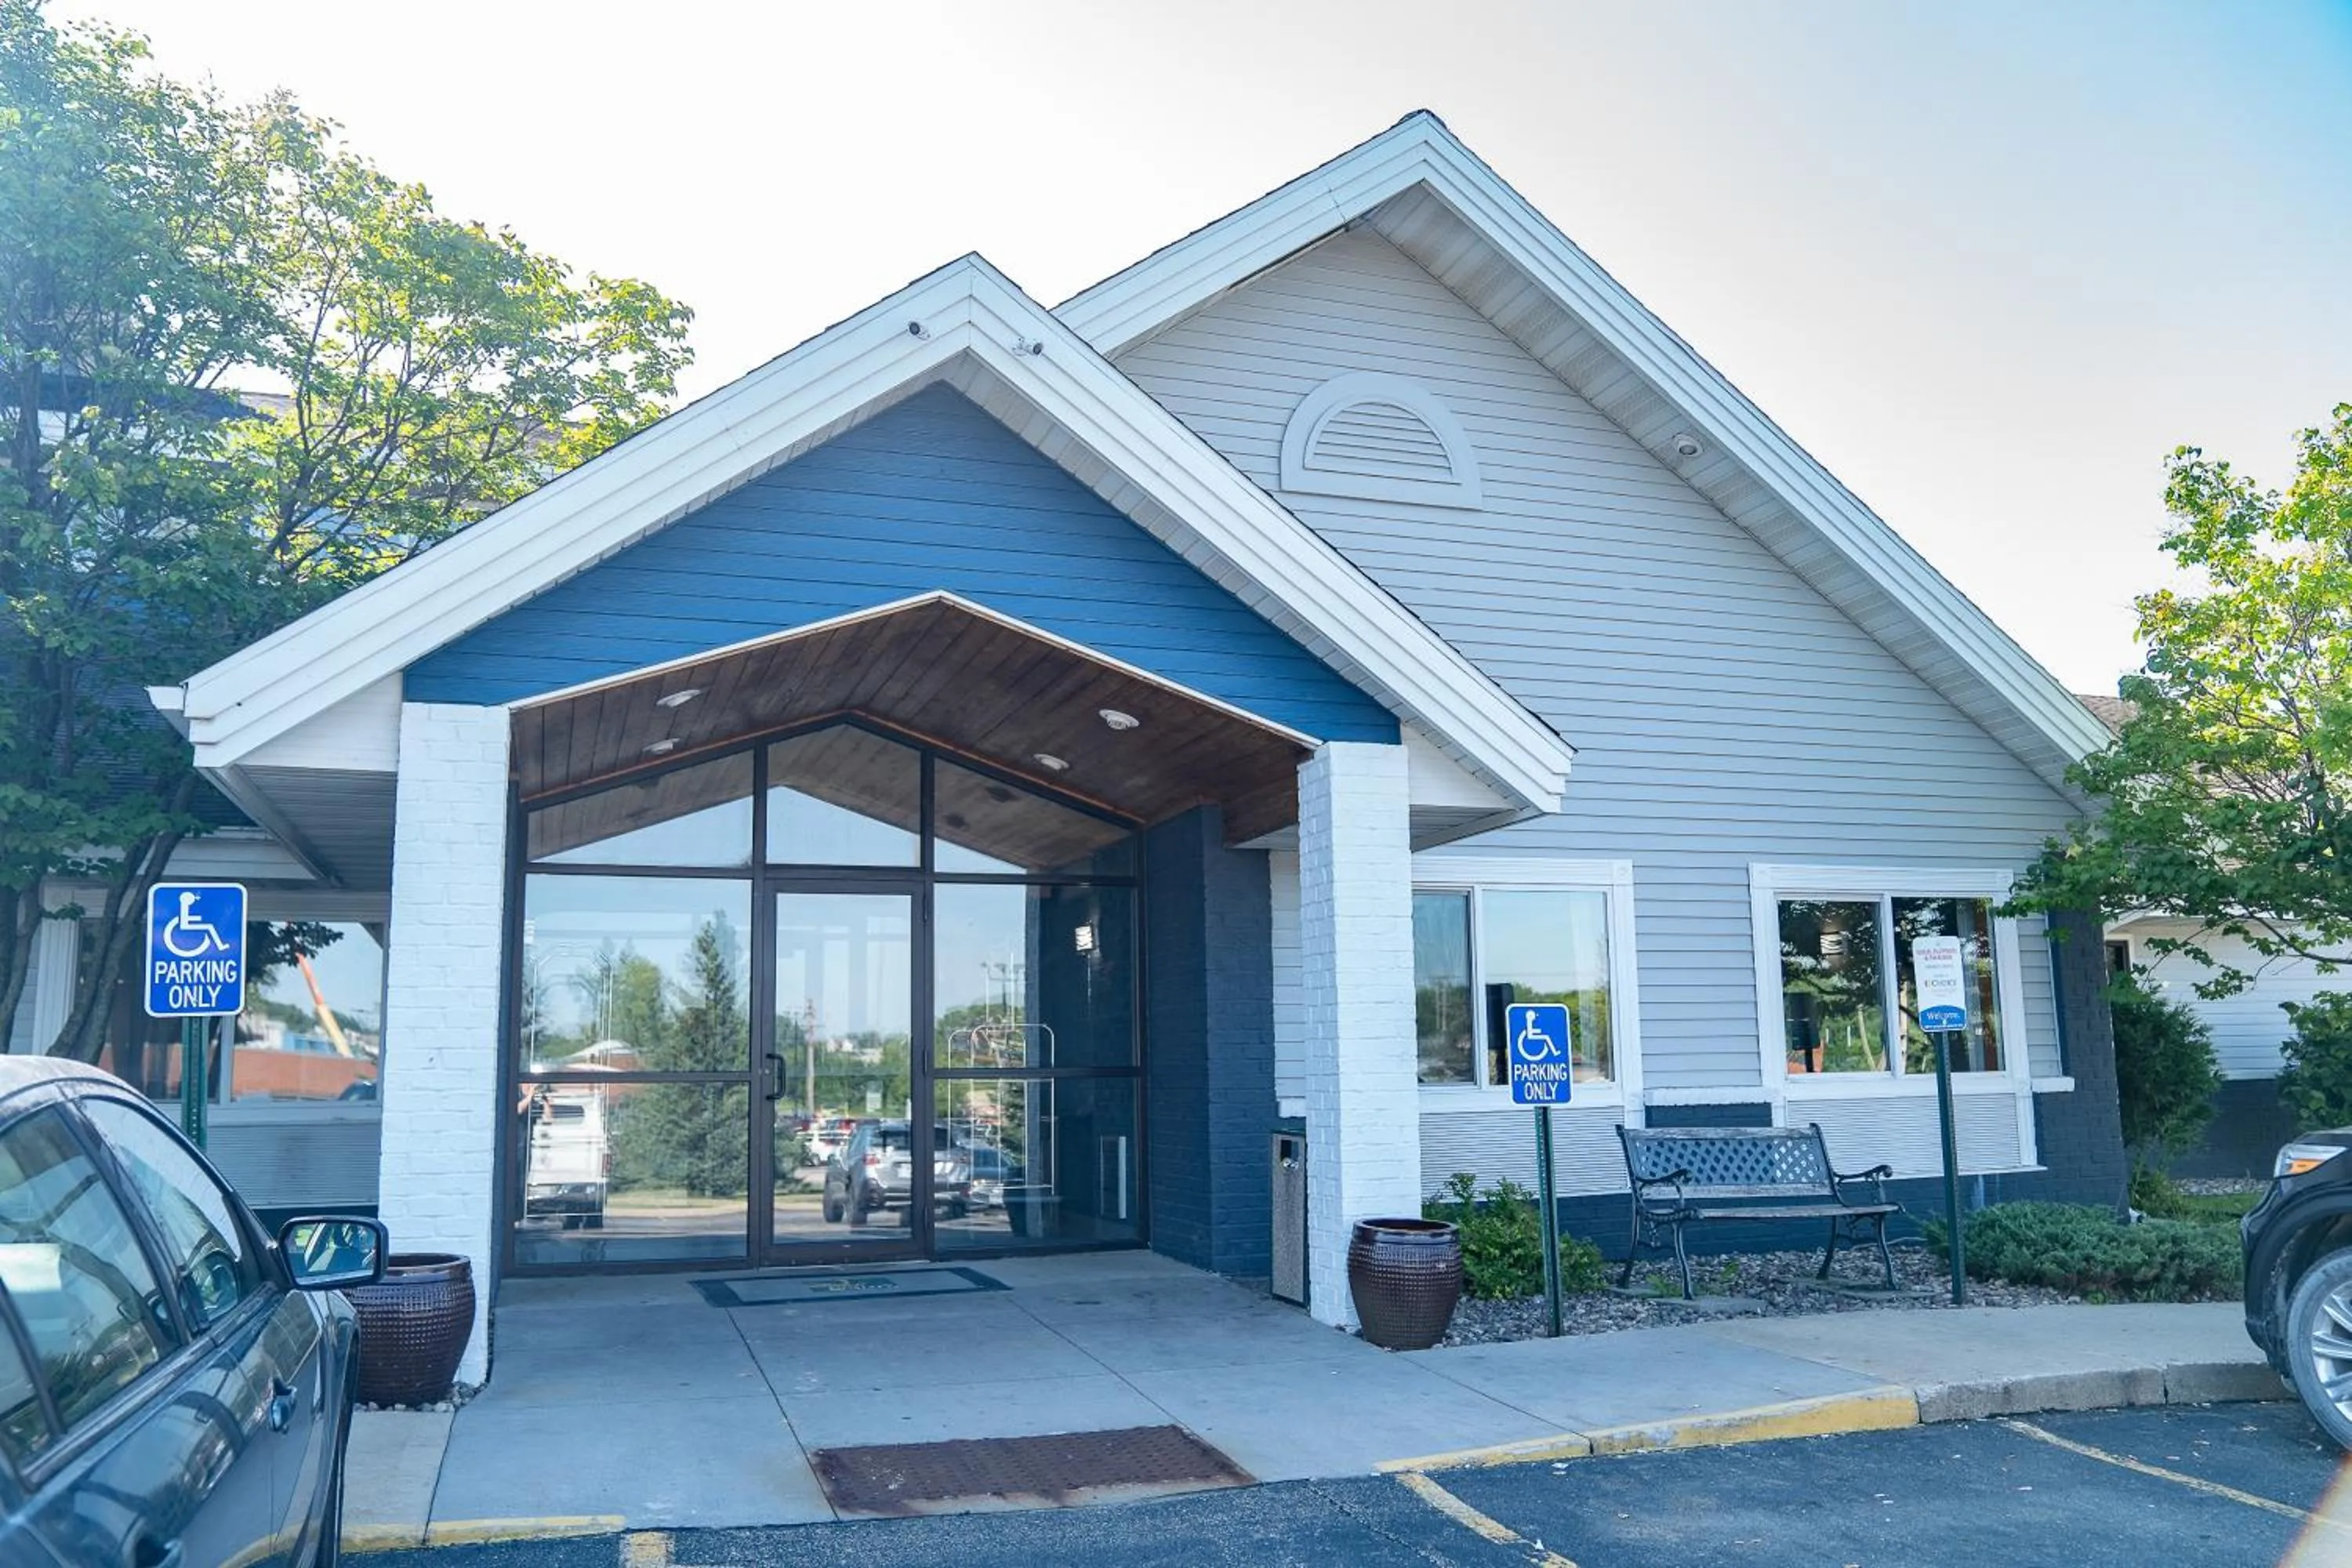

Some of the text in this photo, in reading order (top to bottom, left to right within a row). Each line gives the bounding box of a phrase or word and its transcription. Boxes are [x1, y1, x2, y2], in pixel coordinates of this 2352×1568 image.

[154, 960, 237, 984] PARKING
[169, 985, 222, 1009] ONLY
[1514, 1063, 1567, 1081] PARKING
[1524, 1082, 1559, 1101] ONLY
